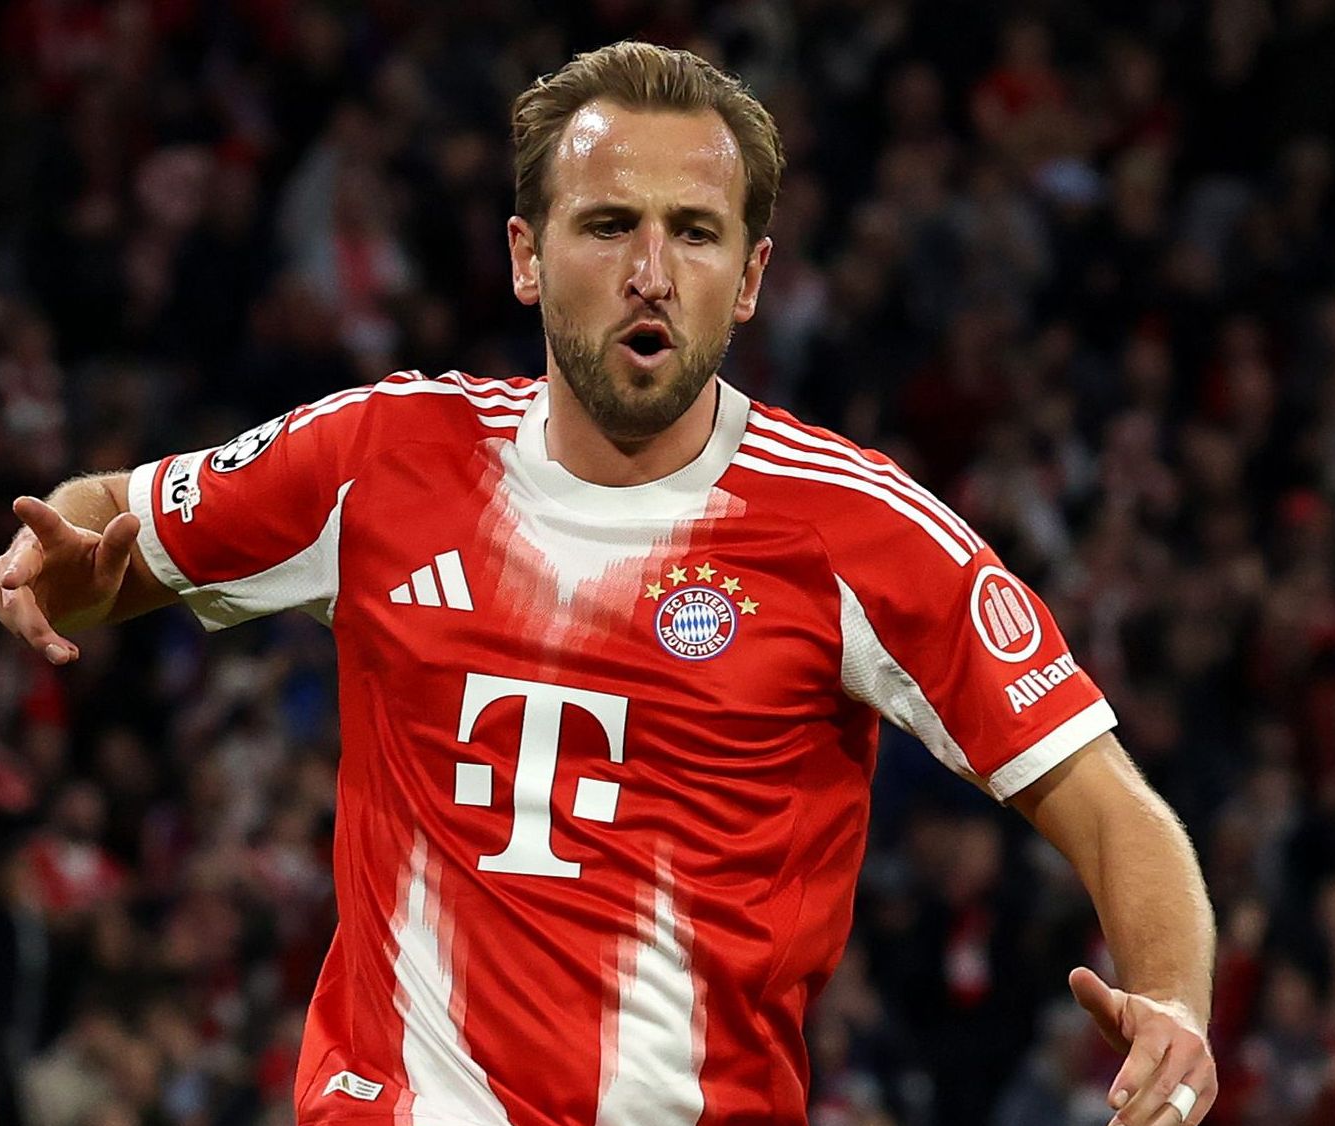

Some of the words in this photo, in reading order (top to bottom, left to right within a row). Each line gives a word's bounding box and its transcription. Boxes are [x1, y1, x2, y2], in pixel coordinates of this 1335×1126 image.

[665, 598, 683, 615] FC
[684, 592, 731, 623] BAYERN
[1004, 651, 1080, 714] Allian
